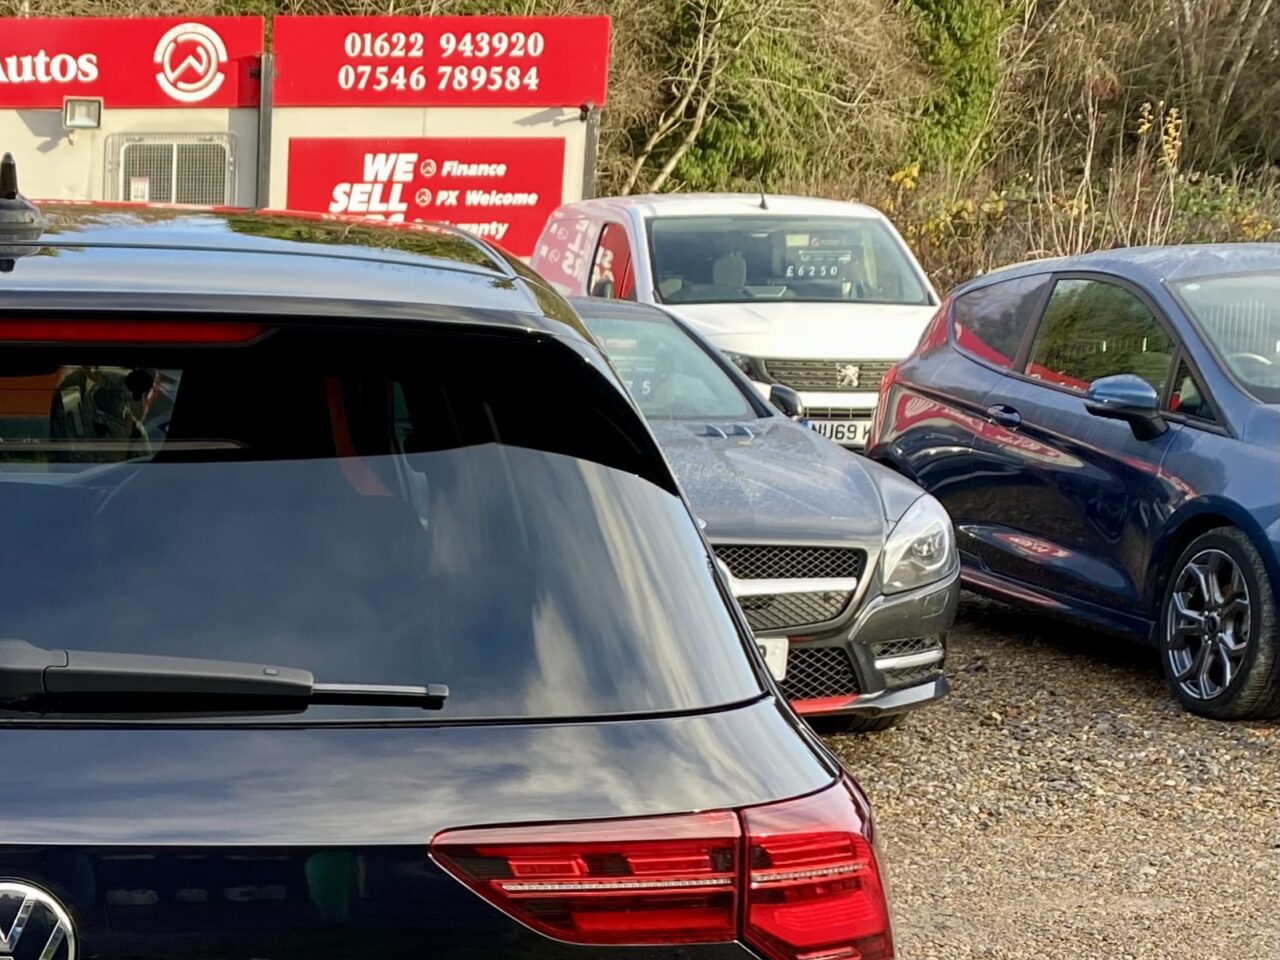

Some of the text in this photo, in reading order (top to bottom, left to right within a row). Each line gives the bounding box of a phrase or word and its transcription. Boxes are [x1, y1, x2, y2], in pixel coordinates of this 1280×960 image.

[343, 31, 546, 58] 01622 943920
[338, 64, 539, 91] 07546 789584
[363, 153, 419, 183] WE
[440, 160, 507, 177] Finance
[328, 182, 408, 213] SELL
[434, 189, 539, 206] PX Welcome
[785, 264, 838, 277] £6250
